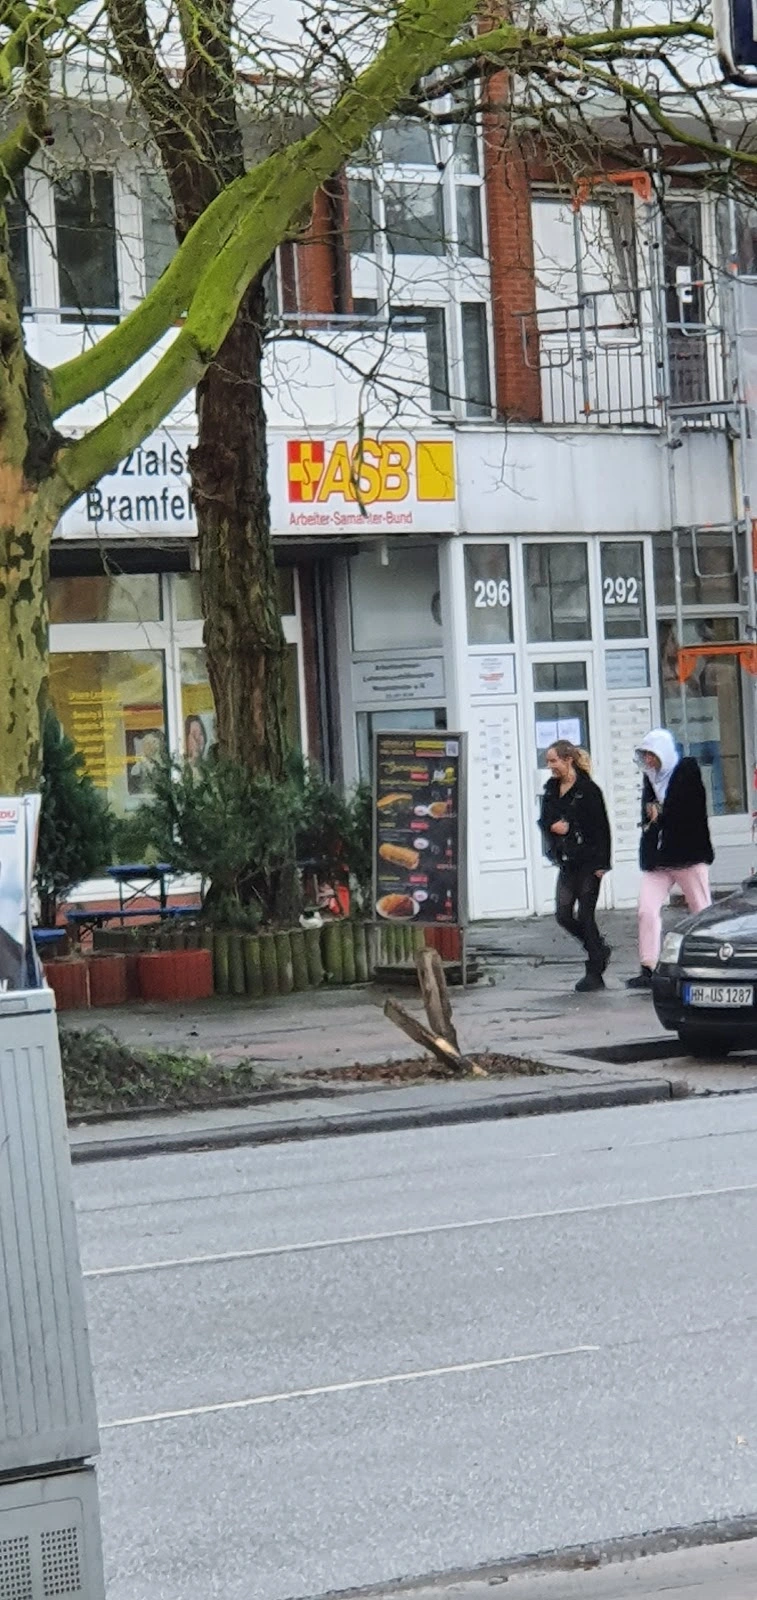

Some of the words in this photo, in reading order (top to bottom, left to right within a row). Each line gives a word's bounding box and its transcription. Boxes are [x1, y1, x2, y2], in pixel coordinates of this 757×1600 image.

[103, 442, 192, 476] zials
[317, 438, 412, 505] ASB
[86, 487, 193, 521] Bramfel
[289, 510, 413, 526] Arbeiter-Samater-Bund
[474, 579, 510, 608] 296
[603, 577, 638, 604] 292
[0, 810, 16, 819] DU
[726, 988, 752, 1003] 1287
